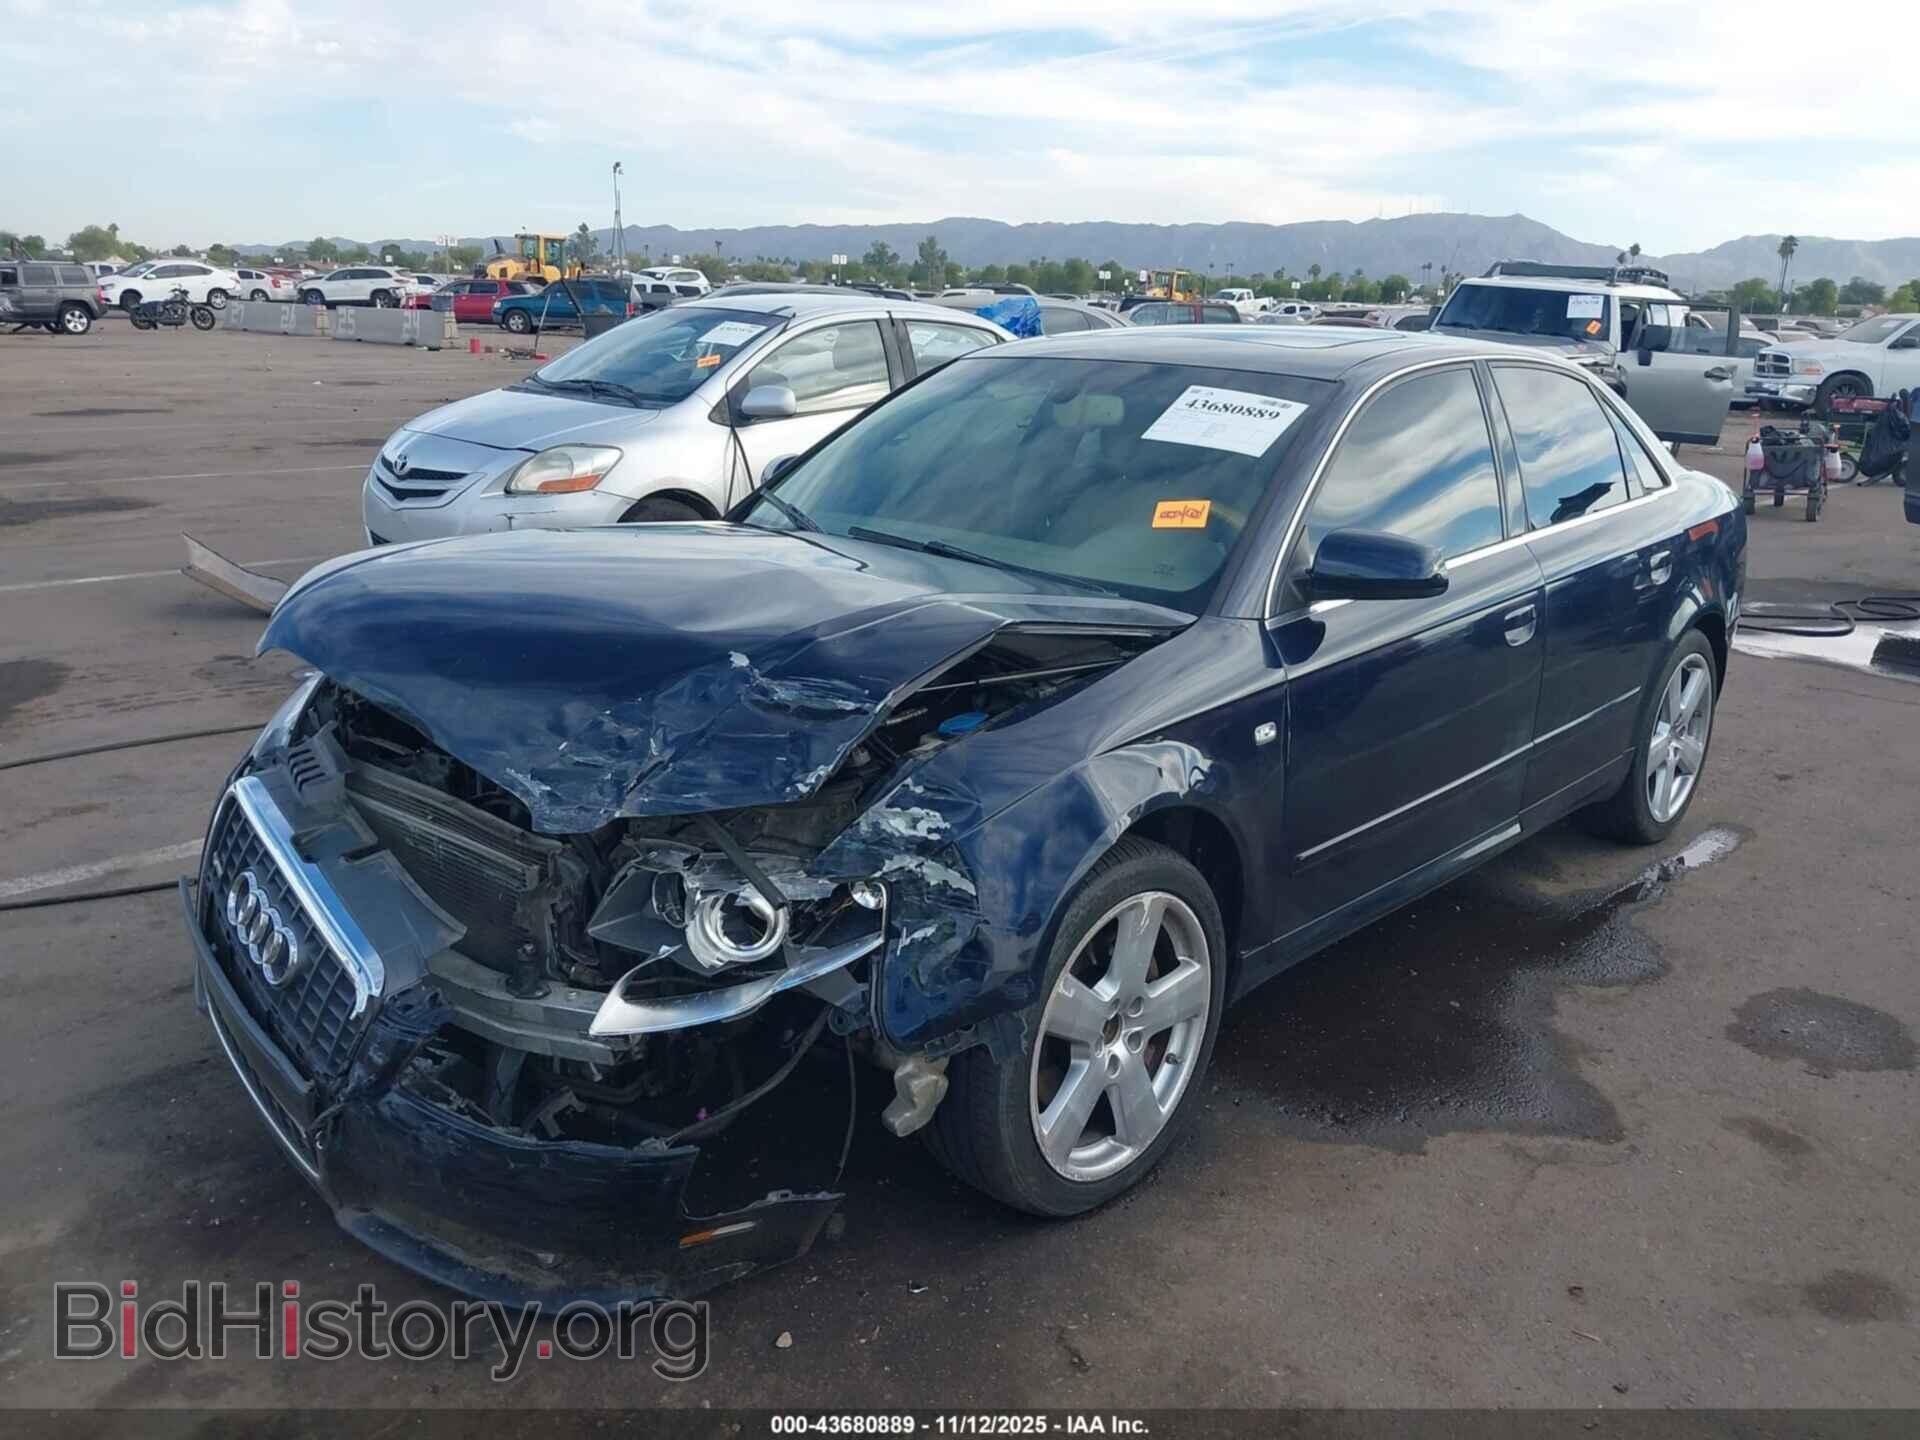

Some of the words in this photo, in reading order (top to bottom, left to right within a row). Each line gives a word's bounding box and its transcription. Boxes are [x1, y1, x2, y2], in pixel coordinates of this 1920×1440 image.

[280, 303, 297, 329] 26
[337, 306, 356, 335] 25
[1185, 399, 1281, 420] 43680889
